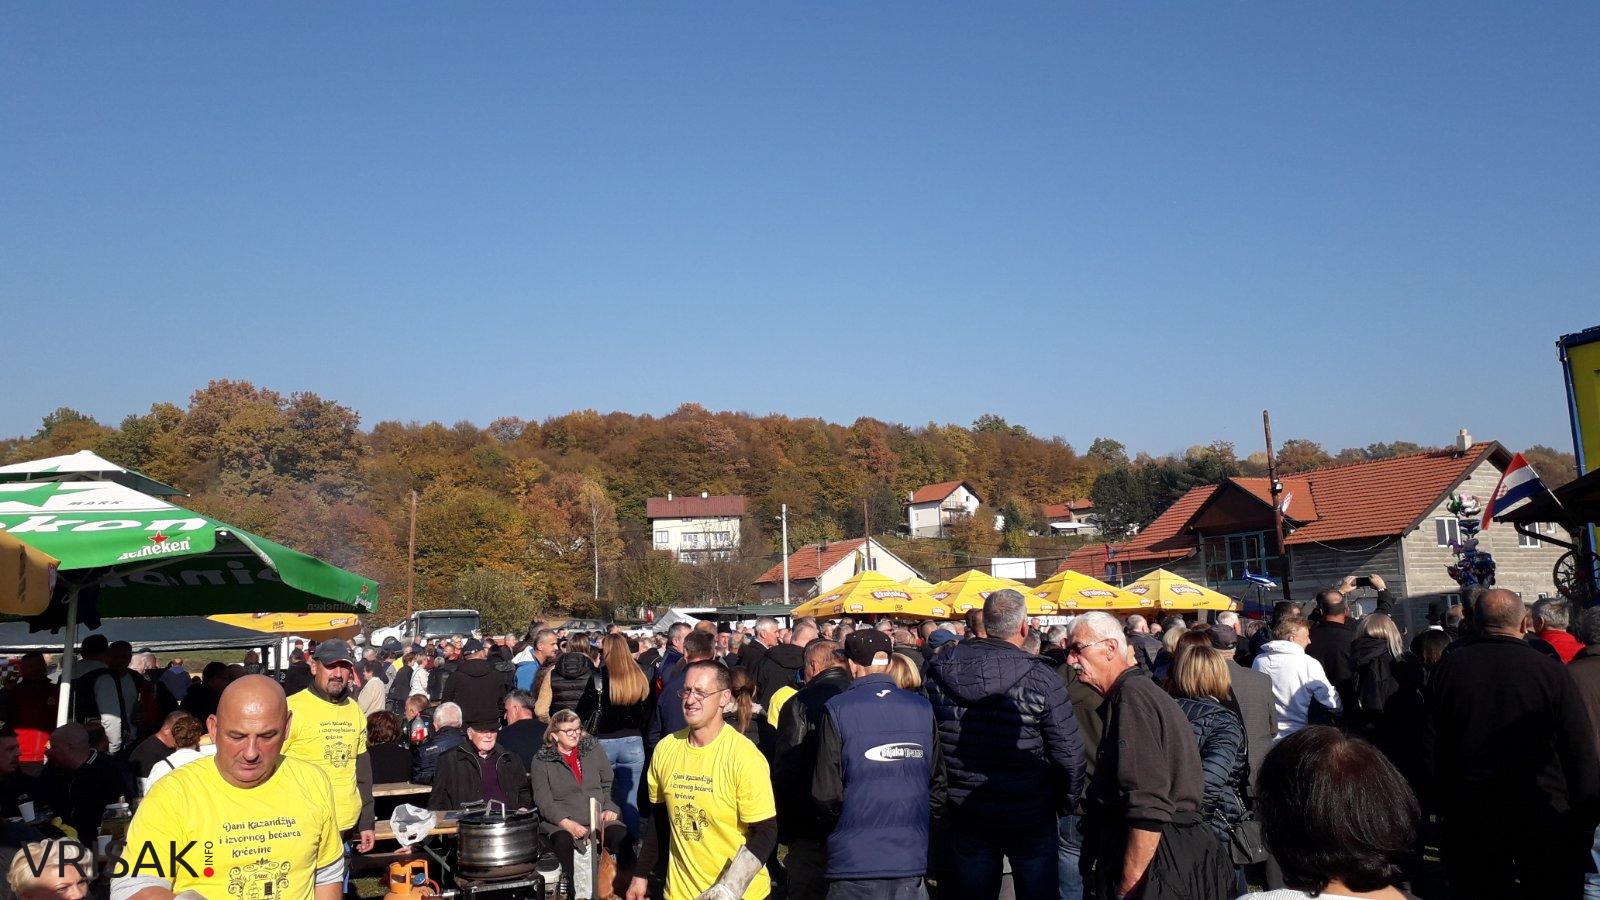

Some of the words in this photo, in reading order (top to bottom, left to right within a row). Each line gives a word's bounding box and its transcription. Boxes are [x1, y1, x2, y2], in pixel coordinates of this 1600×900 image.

[222, 822, 246, 832] Dani
[225, 834, 266, 843] izvornog
[231, 846, 272, 858] Krčevine
